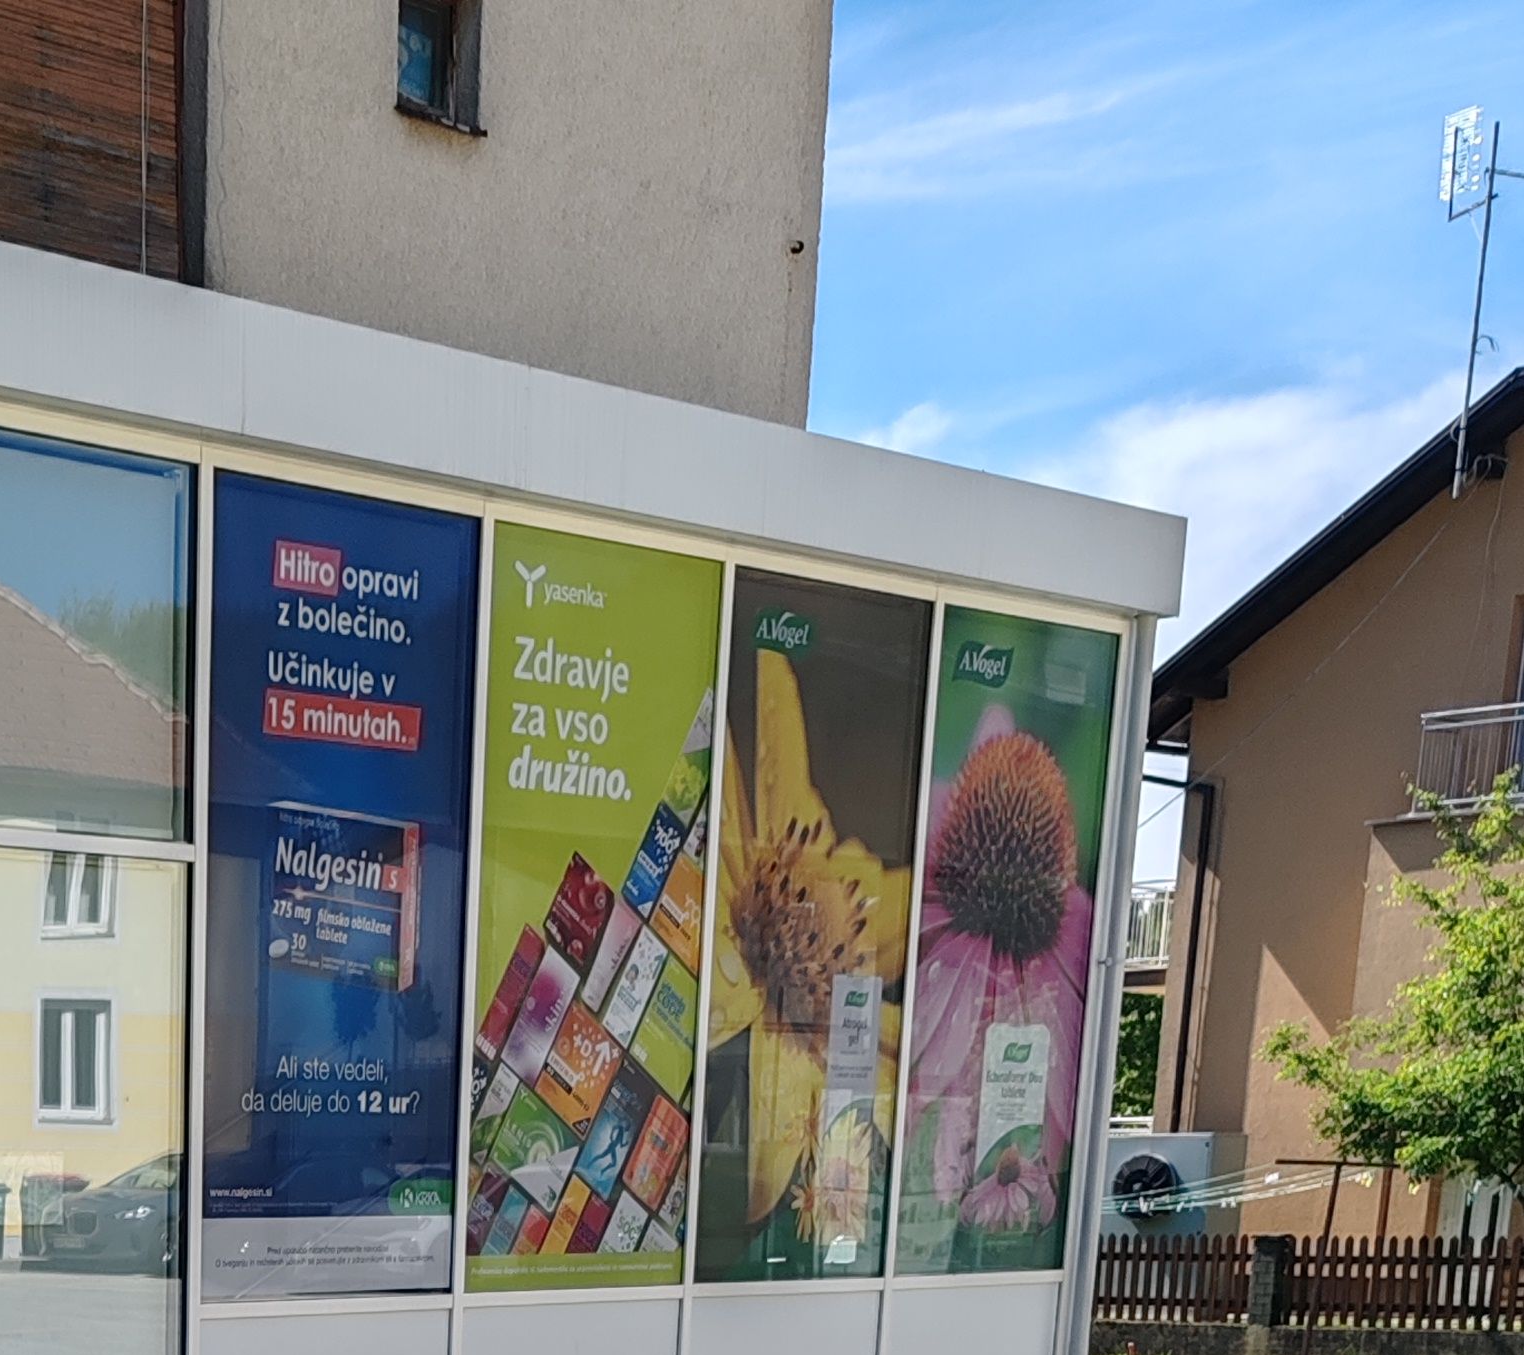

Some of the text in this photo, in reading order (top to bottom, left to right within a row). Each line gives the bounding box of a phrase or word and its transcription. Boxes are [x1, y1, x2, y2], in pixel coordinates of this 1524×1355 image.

[279, 548, 419, 600] Hitro opravi
[544, 583, 605, 608] yasenka
[277, 597, 411, 645] z bolečino.
[756, 611, 810, 649] A.Vogel
[268, 651, 396, 700] Učinkuje v
[514, 636, 629, 703] Zdravje
[959, 644, 1008, 680] A.Vogel
[267, 697, 406, 744] 15 minutah.
[511, 702, 608, 745] za vso
[508, 744, 631, 801] družino.
[275, 836, 382, 891] Nalgesin
[272, 899, 293, 919] 275
[294, 906, 311, 925] mg
[316, 908, 350, 927] filmsko
[291, 933, 306, 950] 30
[316, 928, 348, 945] tablete
[276, 1055, 388, 1085] Ali ste vedeli,
[242, 1088, 420, 1118] da deluje do 12 ur?
